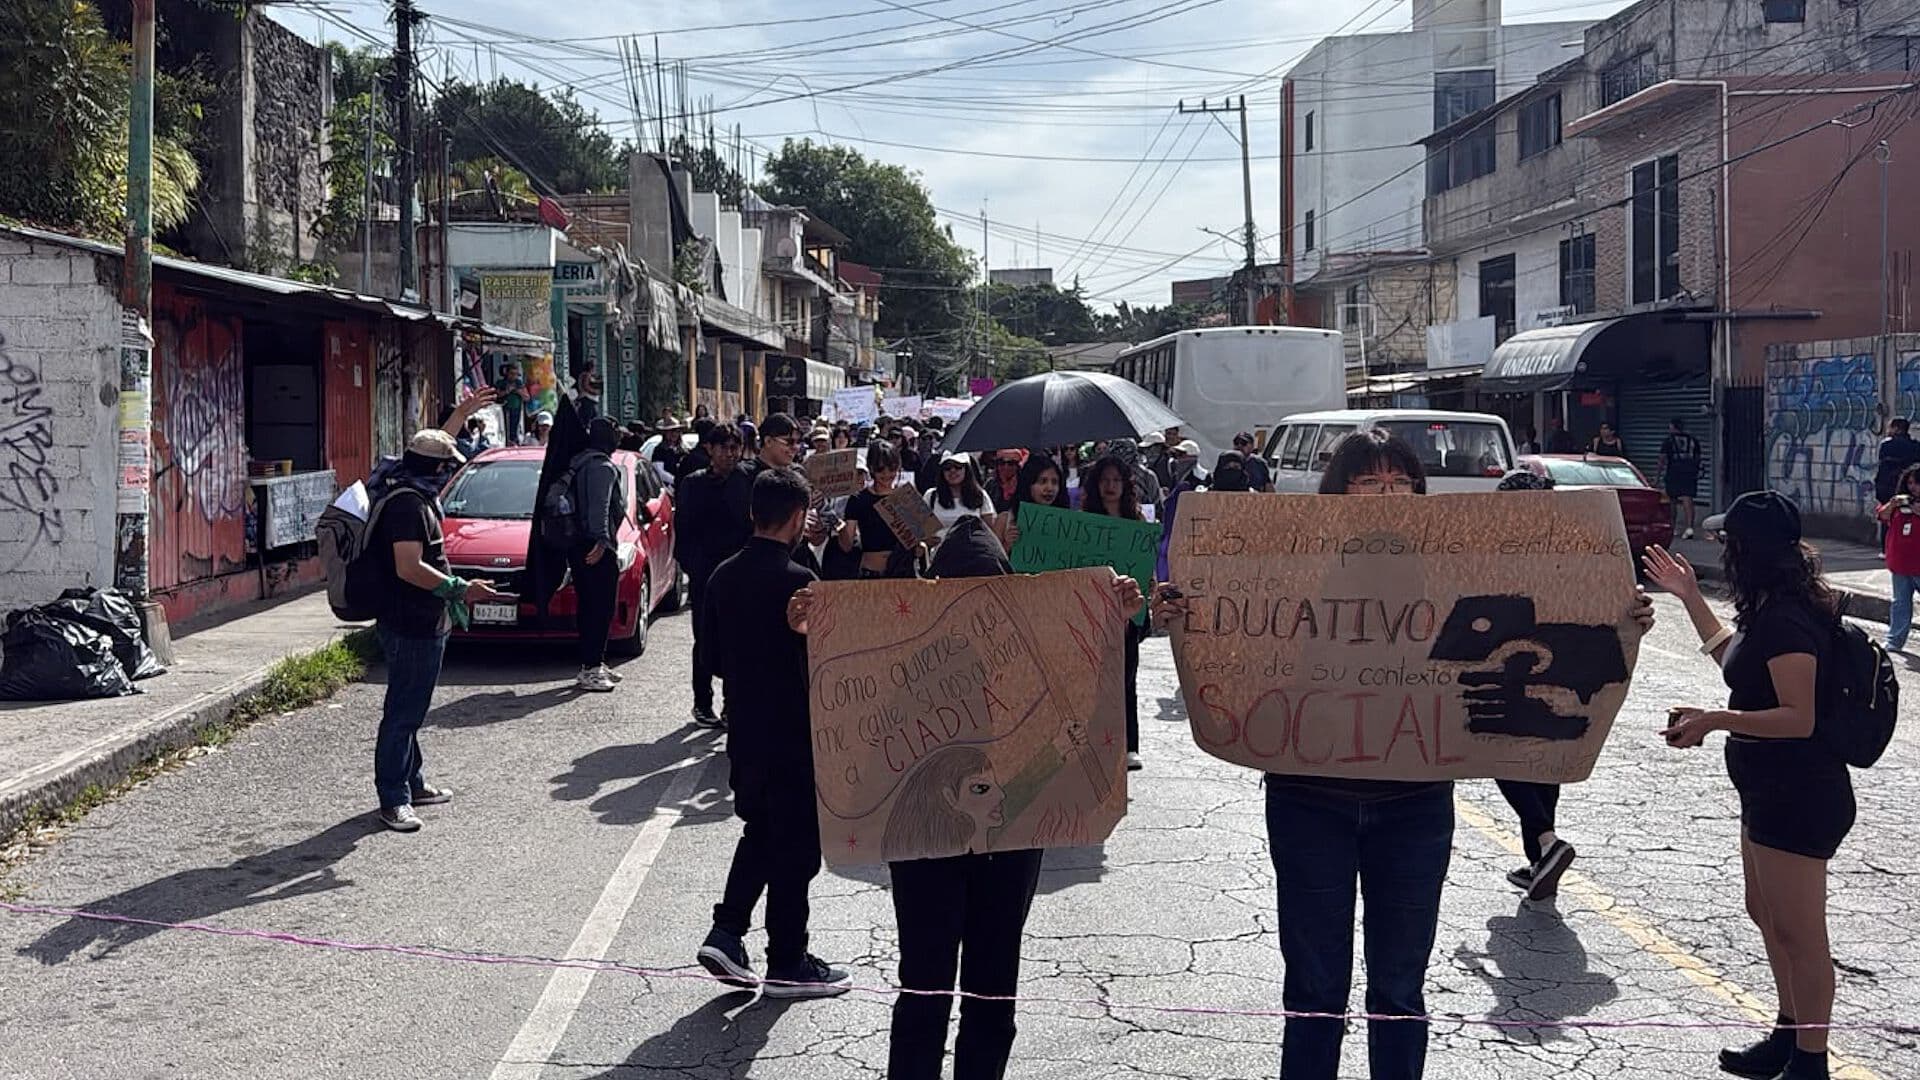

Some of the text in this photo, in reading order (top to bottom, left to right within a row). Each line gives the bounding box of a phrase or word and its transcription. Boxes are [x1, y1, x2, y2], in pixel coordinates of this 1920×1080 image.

[622, 334, 635, 418] COPIAS
[1023, 509, 1160, 553] VENISTE POR
[1188, 516, 1245, 557] Es
[1291, 519, 1465, 568] imposible
[1022, 543, 1047, 565] UN
[1190, 563, 1280, 593] el acto
[1183, 595, 1436, 646] EDUCATIVO
[819, 602, 1007, 711] Cómo quieres que
[1263, 651, 1296, 678] de
[1311, 664, 1346, 682] su
[1358, 656, 1452, 687] contexto
[816, 722, 855, 754] me
[1199, 683, 1466, 766] SOCIAL
[845, 763, 861, 786] a
